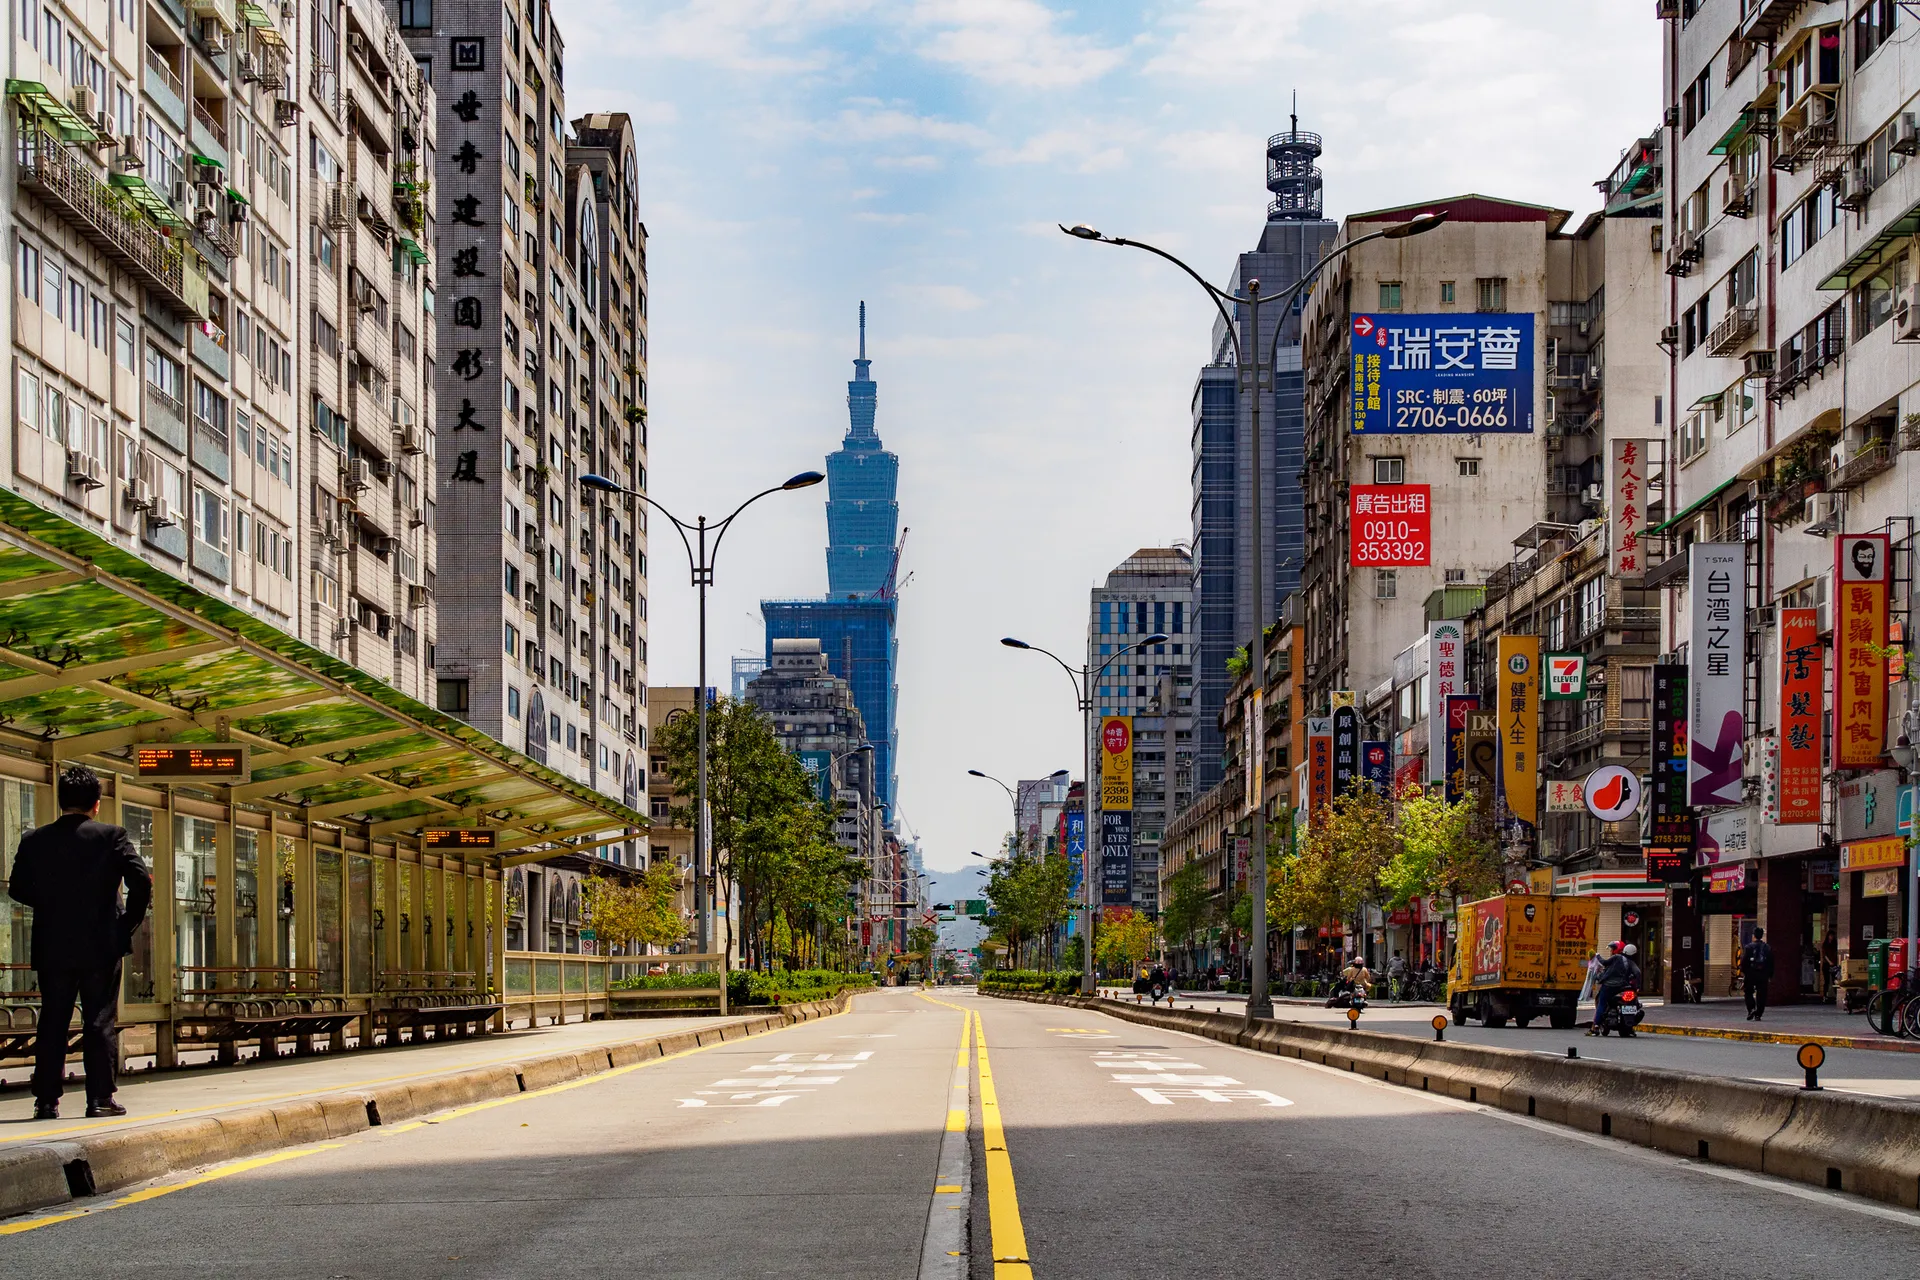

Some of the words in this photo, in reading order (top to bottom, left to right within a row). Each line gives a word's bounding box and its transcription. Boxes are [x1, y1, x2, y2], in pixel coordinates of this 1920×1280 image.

[1367, 354, 1381, 411] 接待會館
[1396, 406, 1508, 428] 2706-0666
[1355, 493, 1426, 515] 廣告出租
[1364, 521, 1420, 540] 0910-
[1357, 541, 1424, 561] 353392
[1509, 681, 1526, 745] 健康人生
[1104, 786, 1129, 794] 2396
[1552, 783, 1584, 803] 素食
[1782, 787, 1819, 795] 水晶指甲
[1104, 796, 1128, 804] 7288
[1103, 815, 1122, 825] FOR
[1108, 834, 1128, 843] EYES
[1102, 845, 1131, 857] ONLY
[1516, 971, 1541, 979] 2406
